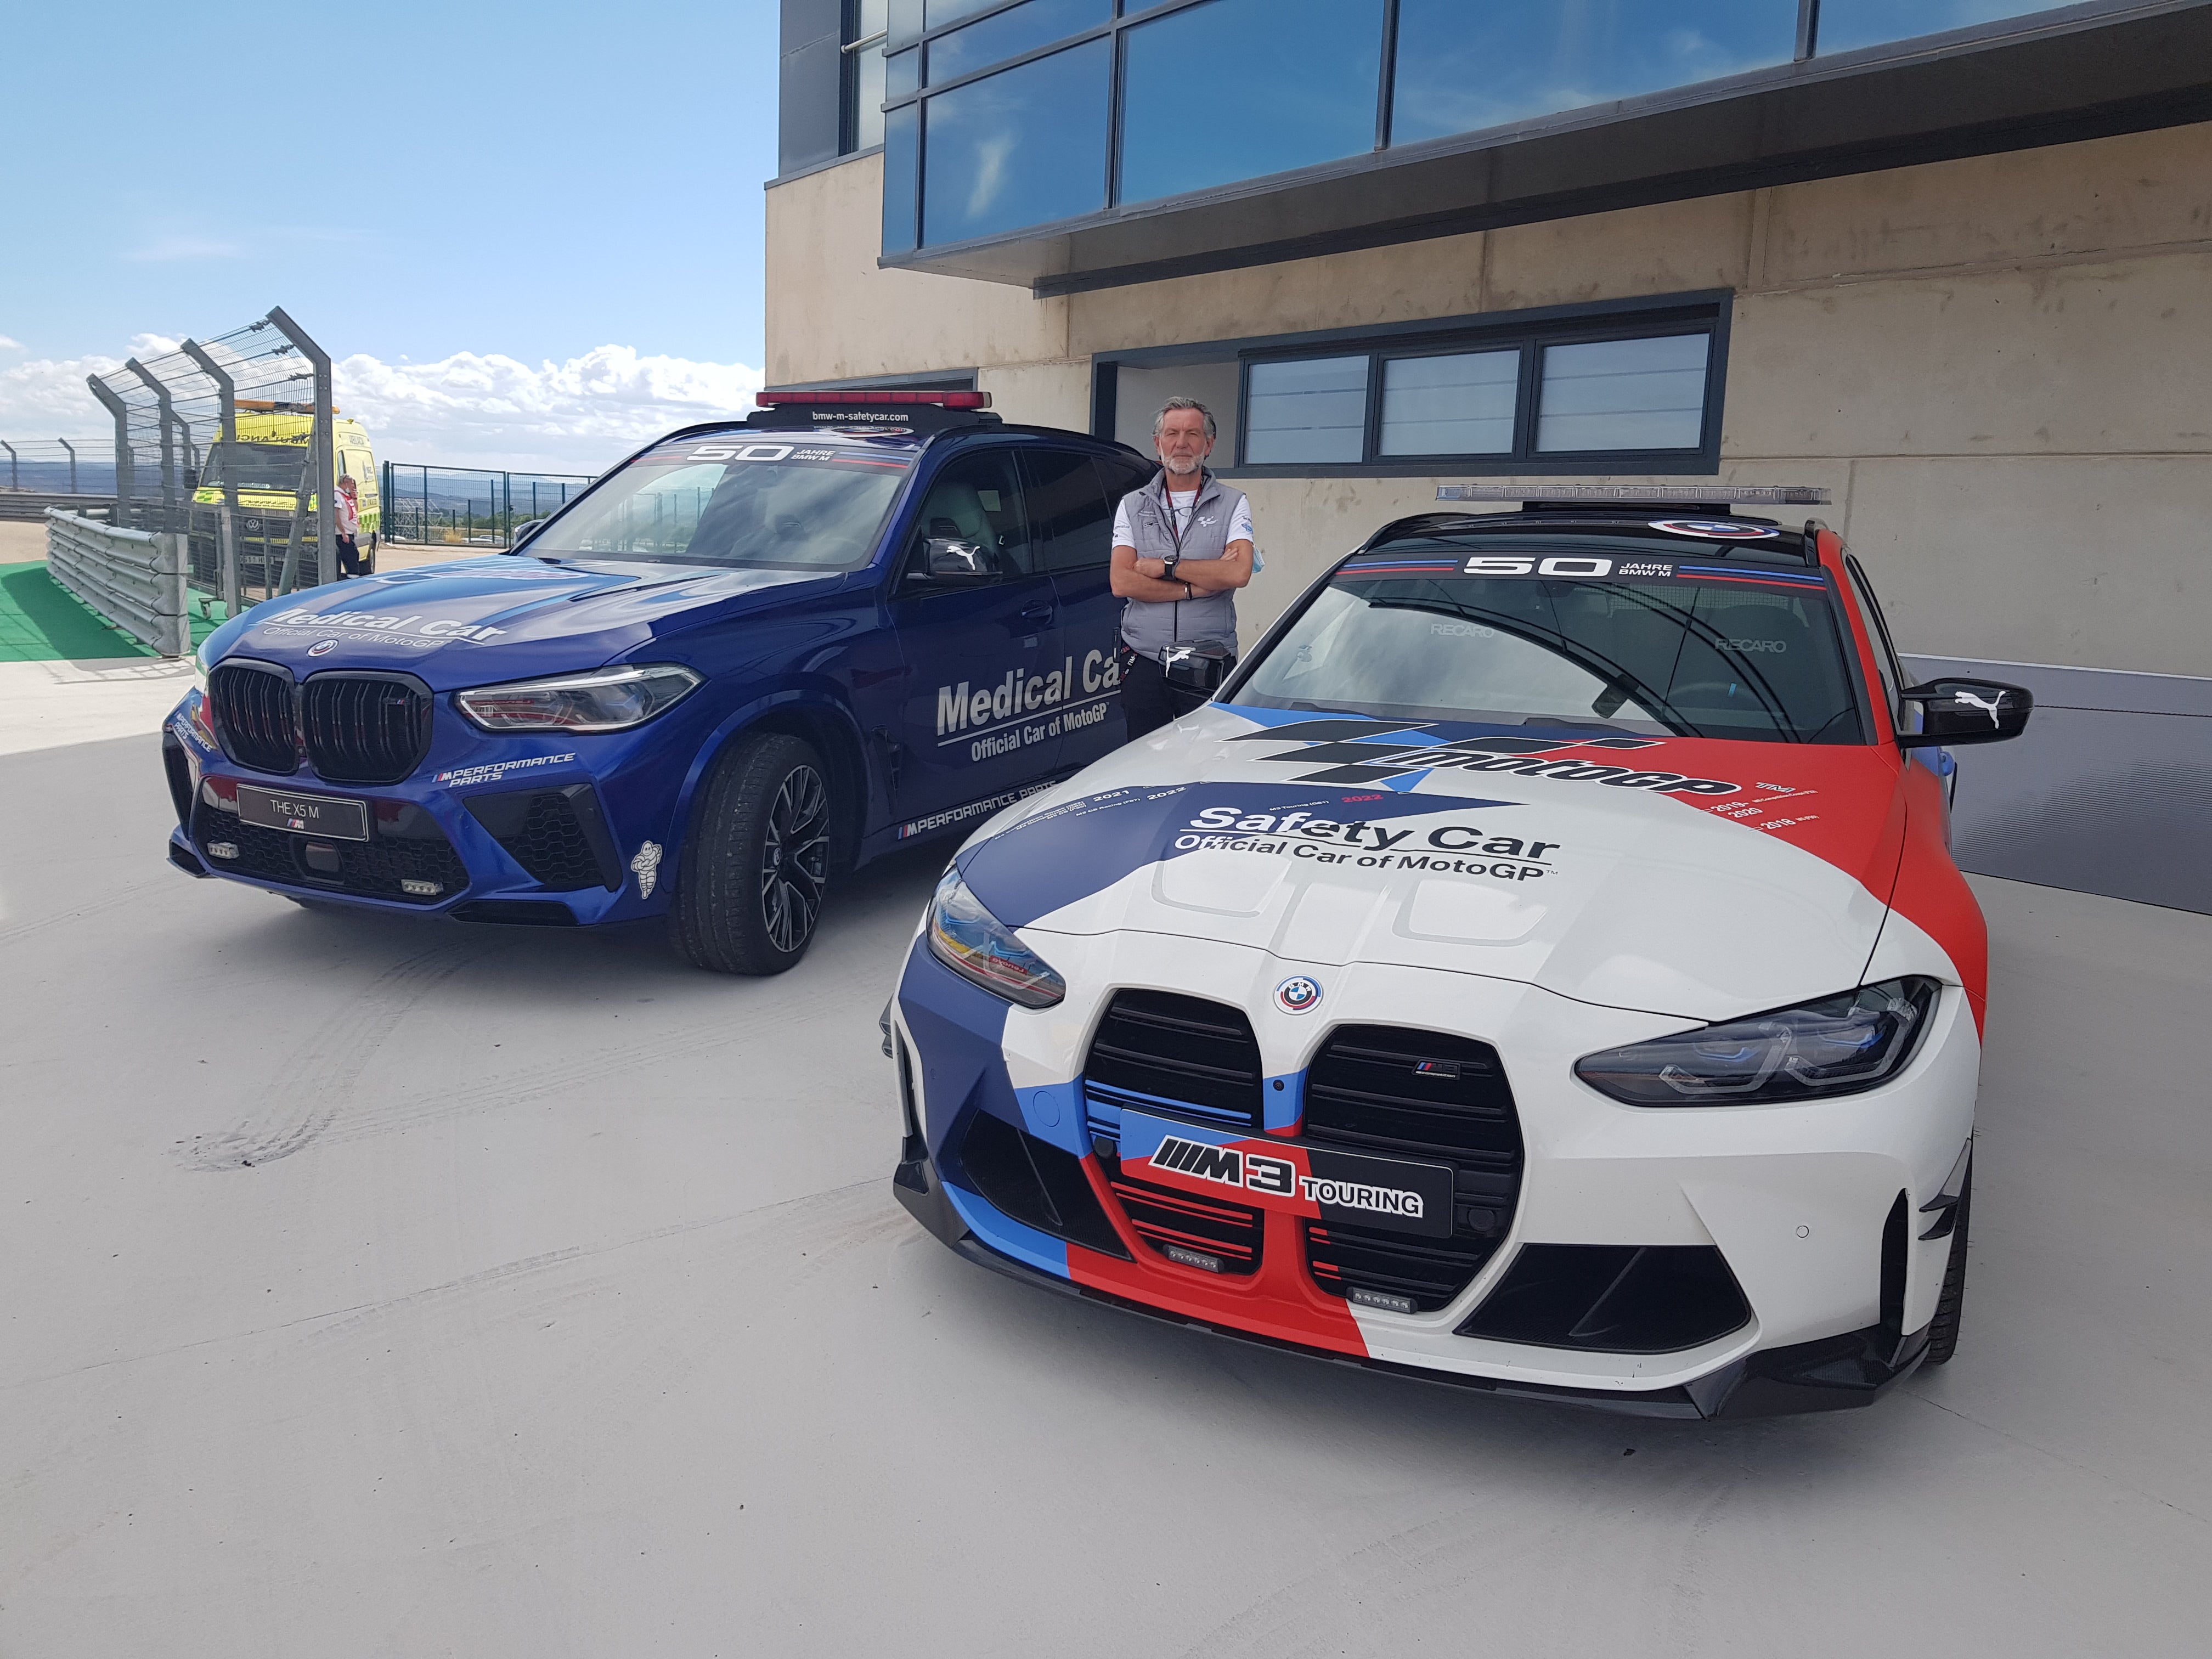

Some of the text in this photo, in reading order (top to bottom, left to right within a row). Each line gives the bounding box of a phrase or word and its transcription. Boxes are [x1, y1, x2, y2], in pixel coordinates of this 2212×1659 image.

[812, 411, 909, 422] bmw-m-safetycar.com
[686, 445, 795, 461] 50
[1463, 556, 1613, 577] 50
[1618, 568, 1658, 577] BMW
[1620, 563, 1673, 571] JAHRE
[255, 608, 508, 641] Medical Car
[1430, 623, 1495, 639] RECARO
[263, 627, 445, 648] Official Car of MotoGP
[1715, 638, 1787, 653] RECARO
[936, 649, 1120, 736] Medical Ca
[173, 721, 189, 740] PARTS
[179, 715, 213, 753] PERFORMANCE
[971, 702, 1107, 761] Official Car of MotoGP
[453, 752, 576, 779] PERFORMANCE
[449, 771, 503, 788] PARTS
[1093, 790, 1130, 802] 2021
[1146, 787, 1187, 800] 2022
[1341, 793, 1384, 803] 2022
[269, 799, 320, 819] THE X5 M
[917, 792, 1017, 833] PERFORMANCE
[1711, 801, 1750, 812] 2019-
[1727, 807, 1764, 819] 2020
[1189, 807, 1561, 859] Safety Car
[1760, 818, 1797, 830] 2018
[1175, 834, 1288, 855] Official
[1293, 844, 1353, 865] Car
[1356, 855, 1395, 868] of
[1396, 856, 1544, 881] MotoGP
[1299, 1175, 1424, 1218] TOURING
